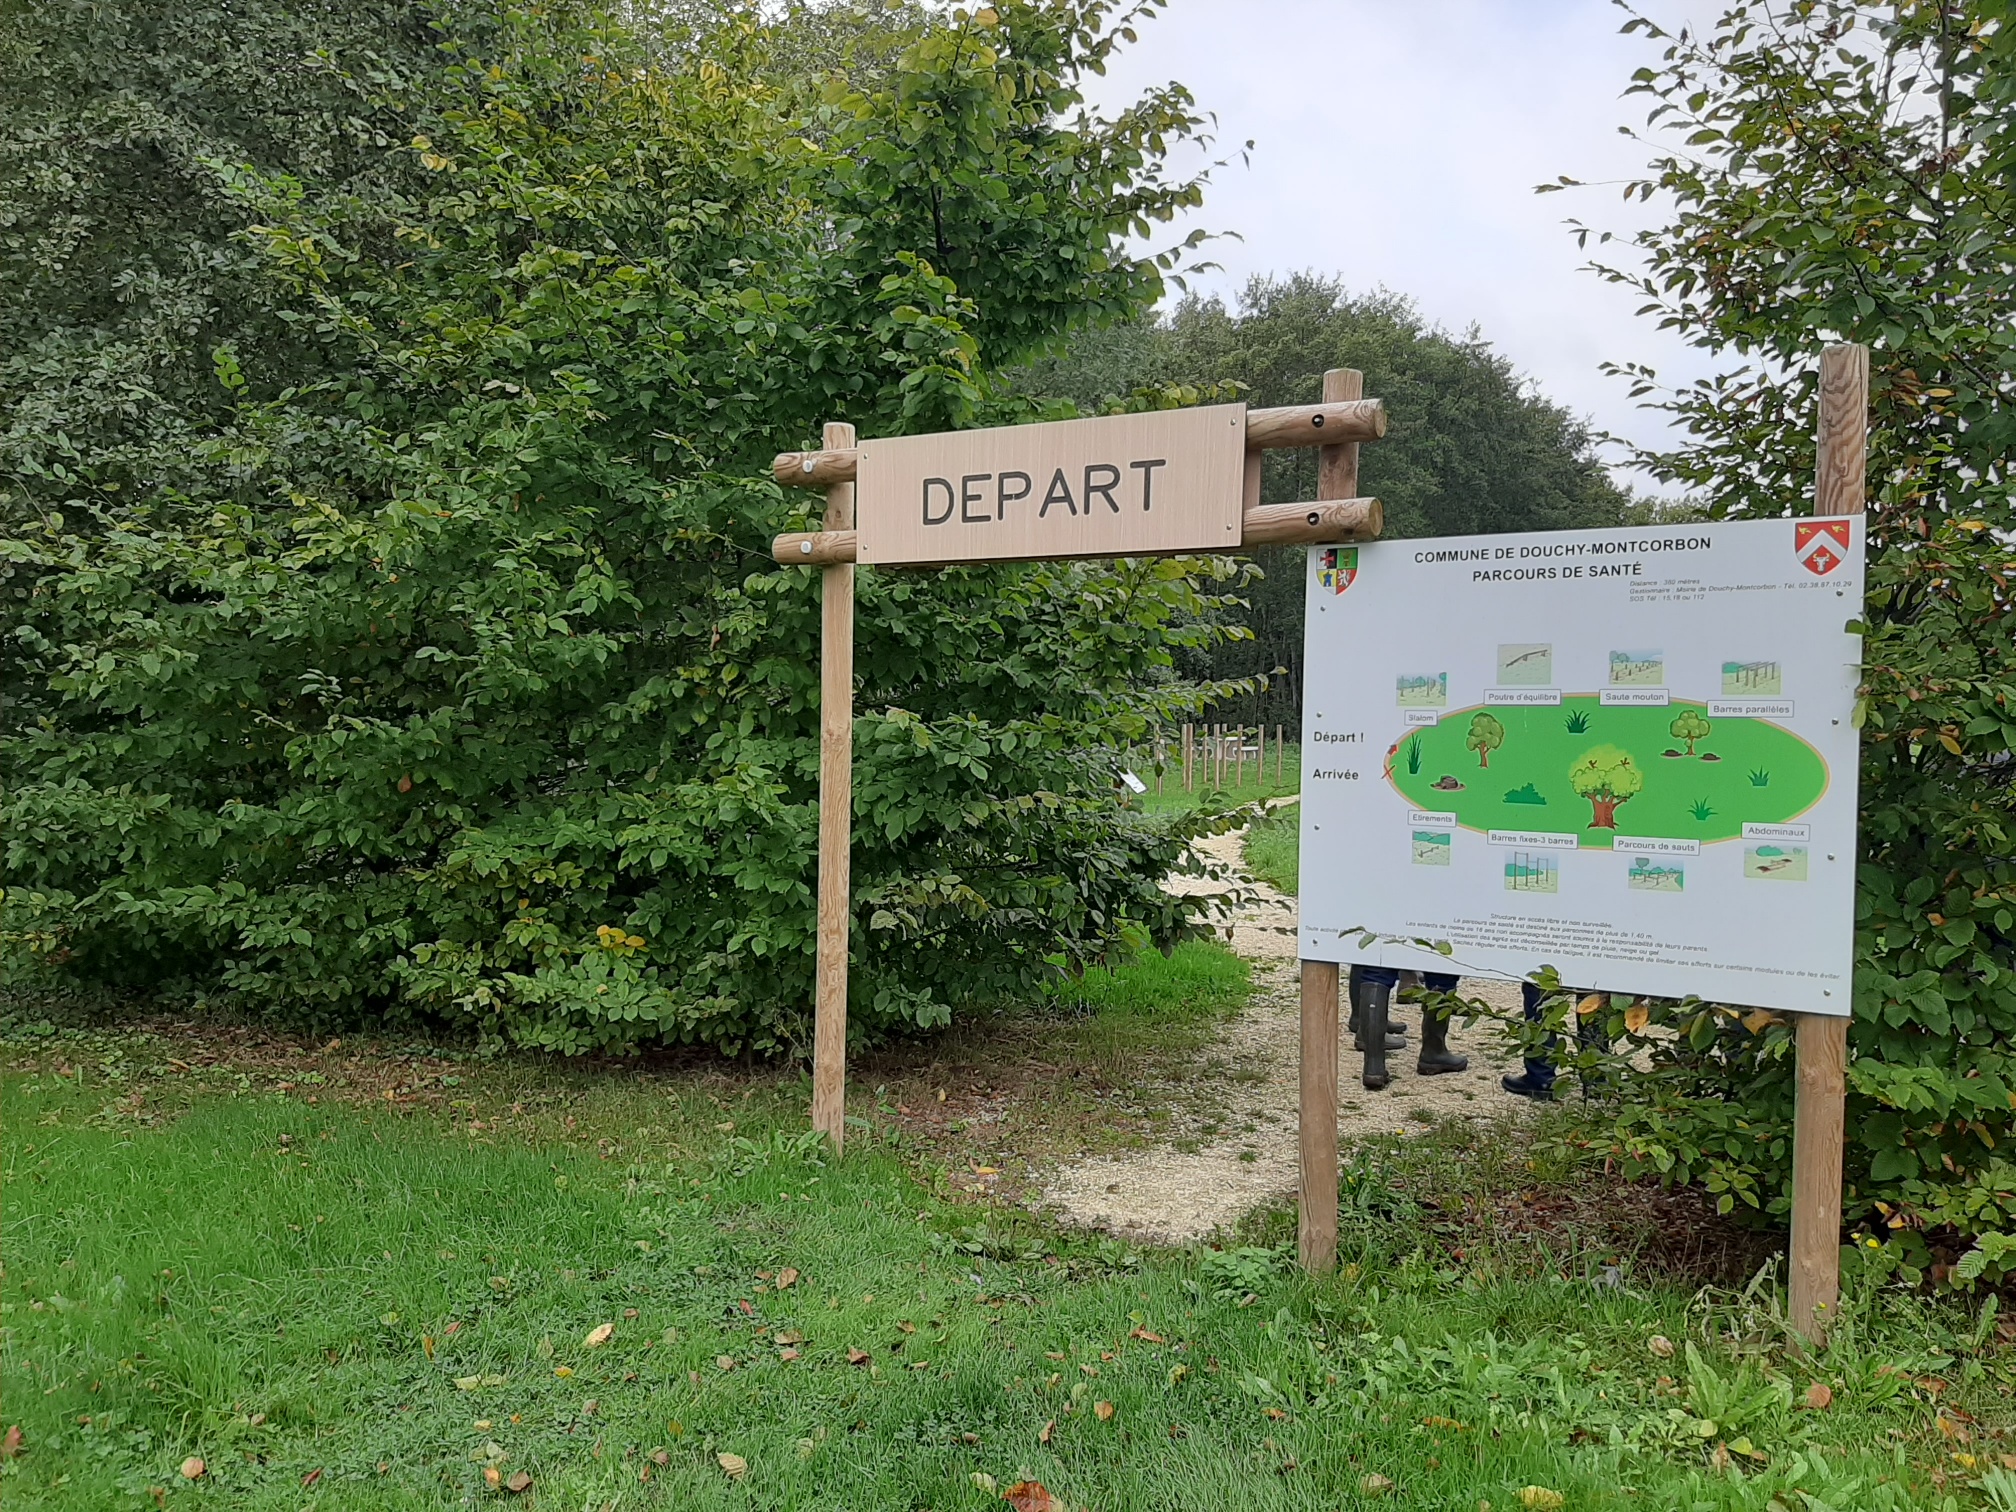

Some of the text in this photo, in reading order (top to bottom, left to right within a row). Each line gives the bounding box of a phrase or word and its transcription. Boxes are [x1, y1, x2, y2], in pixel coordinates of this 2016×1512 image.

[922, 458, 1166, 526] DEPART
[1414, 537, 1711, 563] COMMUNE DE DOUCHY-MONTCORBON
[1472, 560, 1642, 582] PARCOURS DE SANTÉ
[1488, 693, 1558, 702] Poutre d'équilibre
[1605, 693, 1664, 701] Saute mouton
[1713, 705, 1790, 715] Barres parallèles
[1408, 714, 1434, 722] Slalom
[1313, 731, 1357, 744] Départ
[1312, 768, 1359, 780] Arrivée
[1412, 813, 1453, 823] Etirements
[1748, 826, 1806, 837] Abdominaux
[1491, 834, 1517, 843] Barres
[1519, 835, 1546, 844] fixes-3
[1617, 840, 1695, 852] Parcours de sauts
